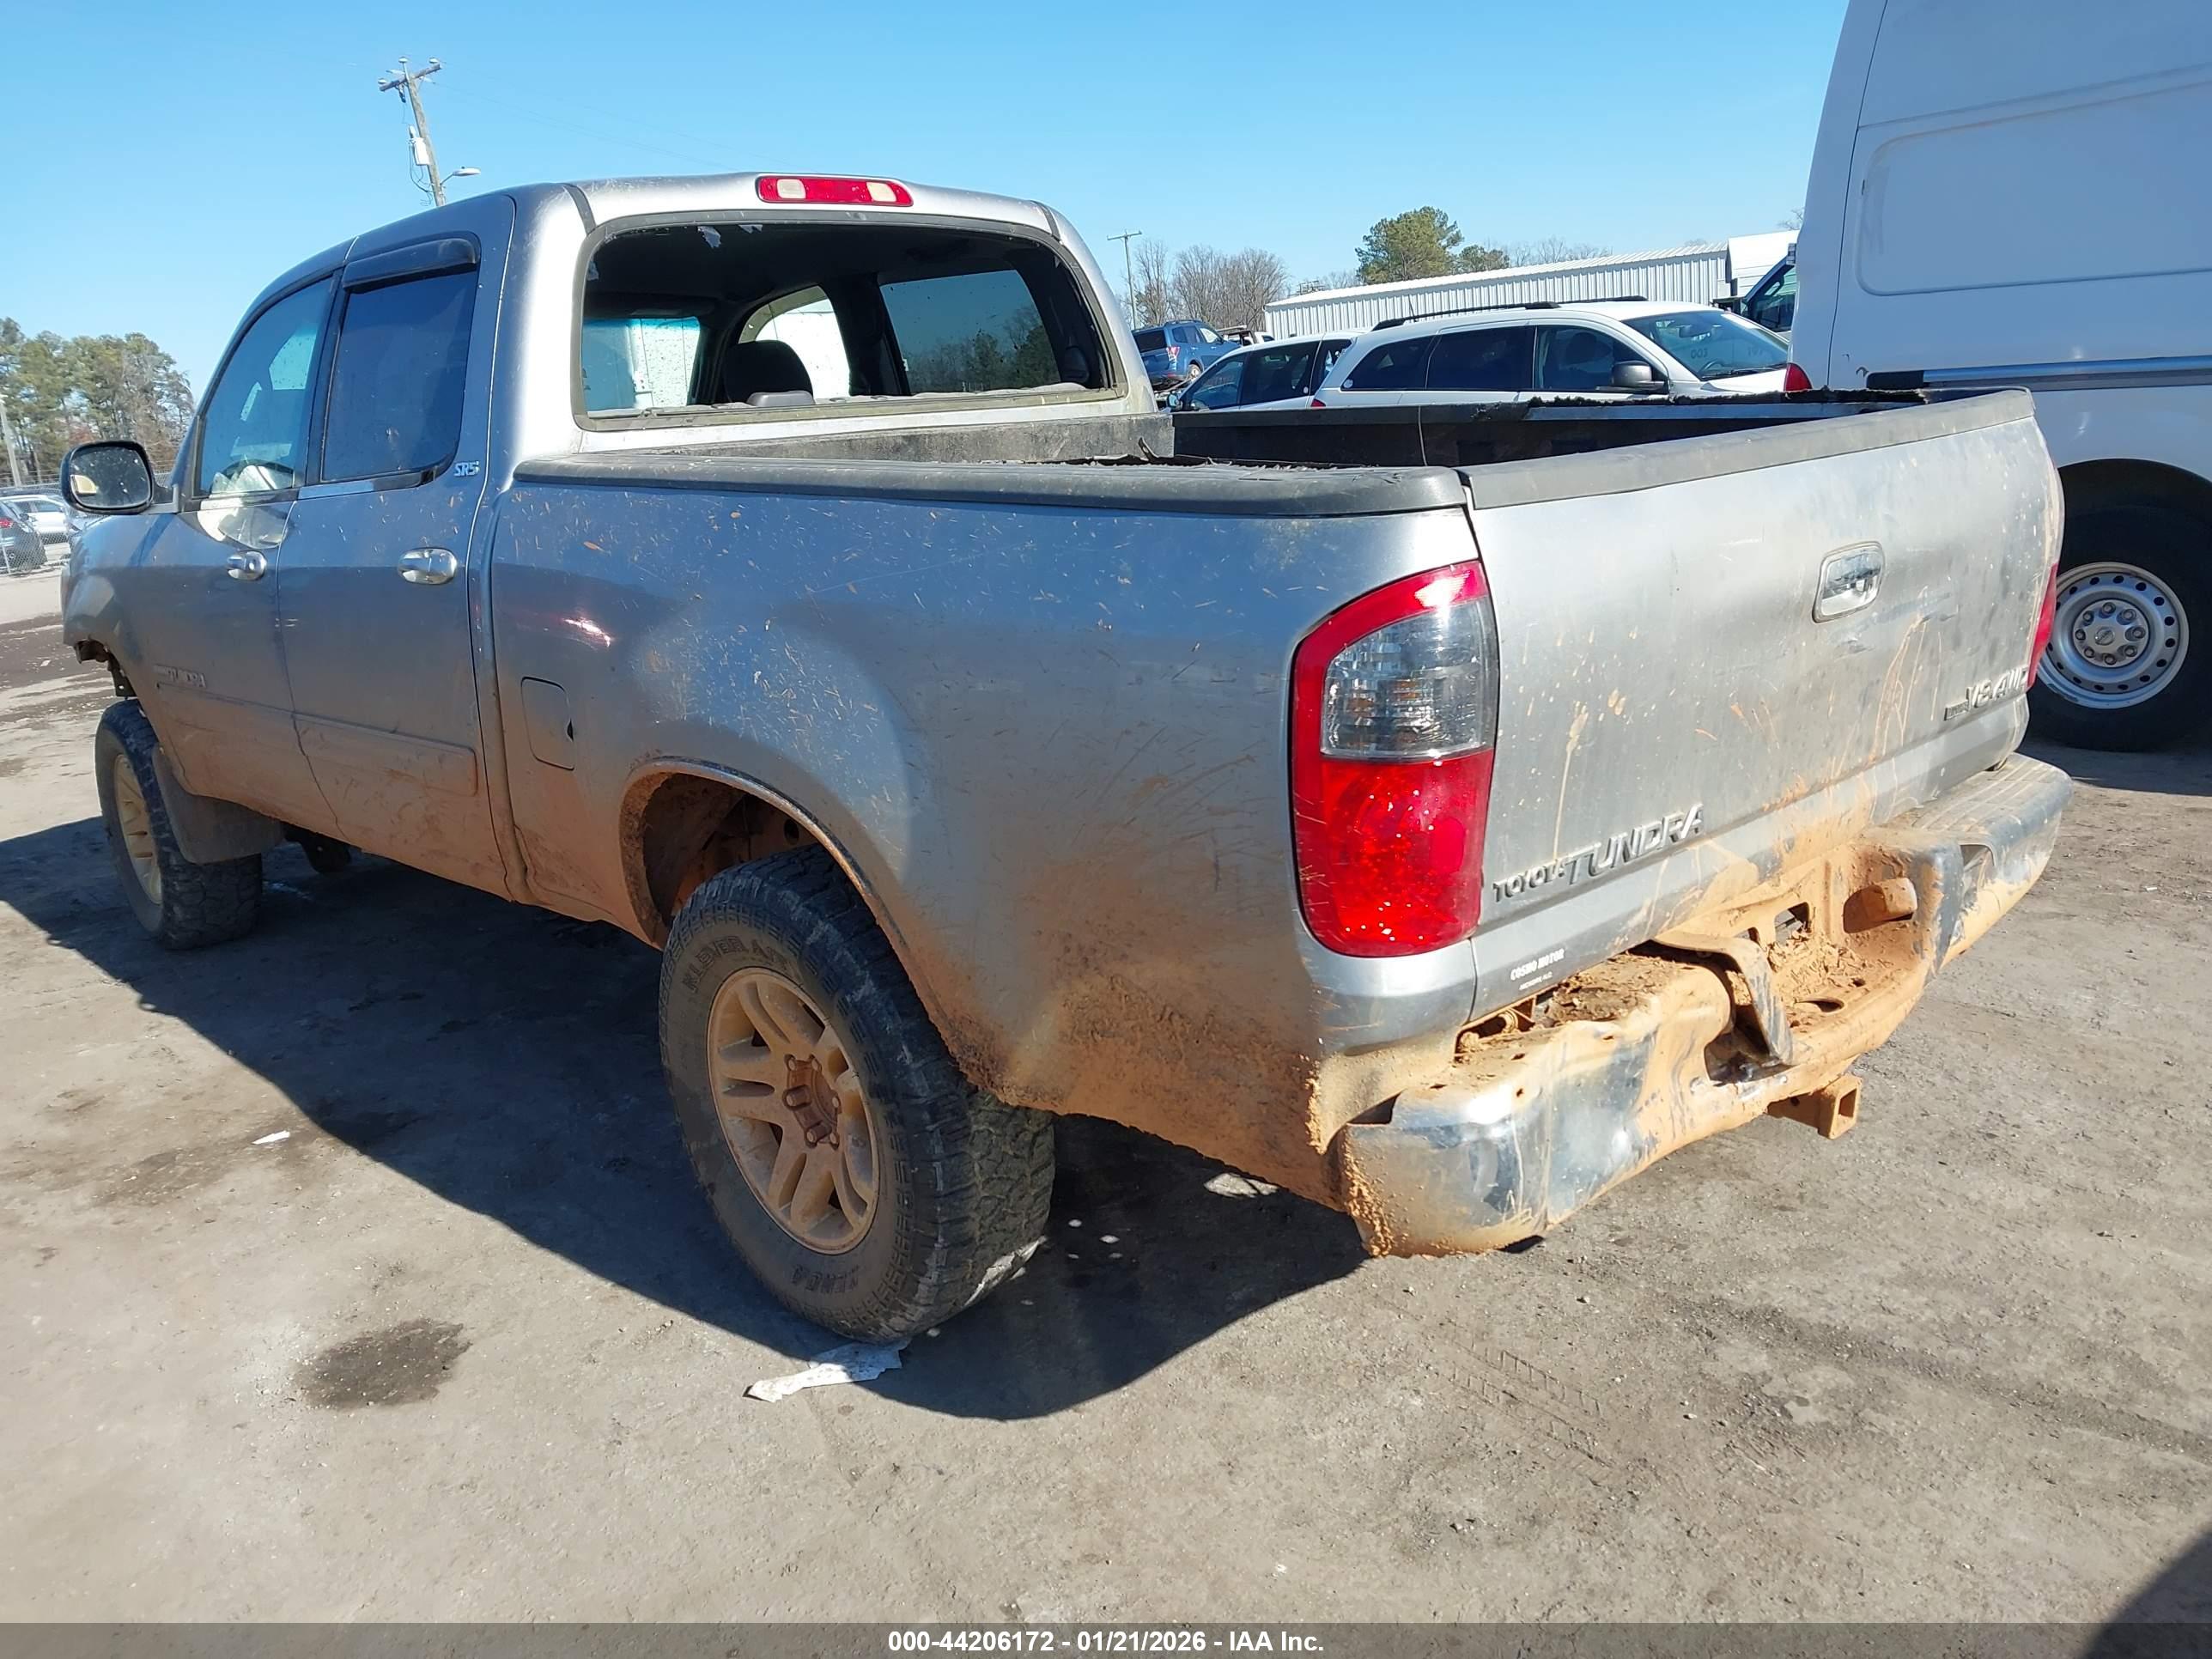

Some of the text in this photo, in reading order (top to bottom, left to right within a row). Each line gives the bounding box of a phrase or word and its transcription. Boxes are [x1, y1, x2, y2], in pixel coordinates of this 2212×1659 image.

[453, 461, 481, 477] SR5
[1492, 803, 1705, 902] TOYOTA TUNDRA
